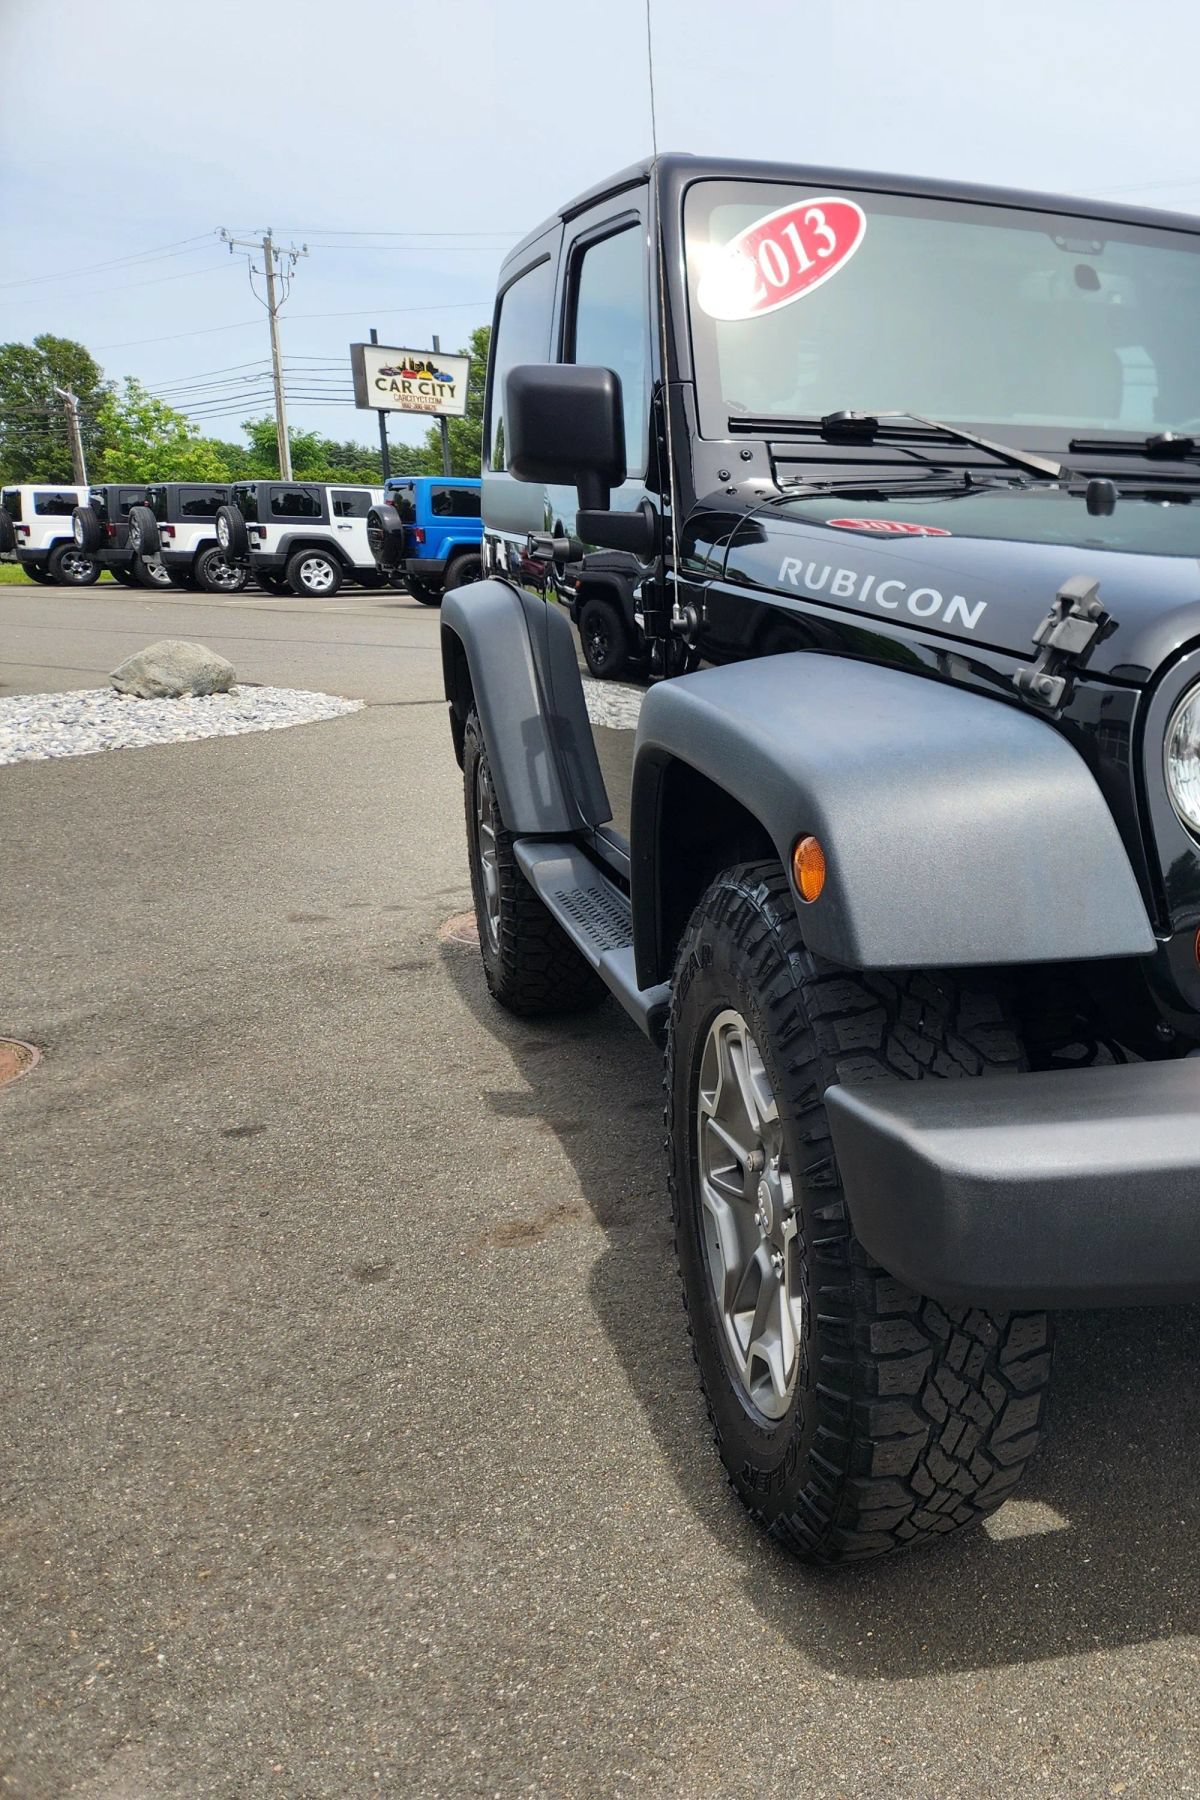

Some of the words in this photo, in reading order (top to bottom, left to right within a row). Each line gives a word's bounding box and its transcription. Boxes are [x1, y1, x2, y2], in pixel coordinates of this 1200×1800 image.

[375, 377, 413, 394] CAR
[418, 382, 456, 399] CITY
[777, 556, 988, 630] RUBICON
